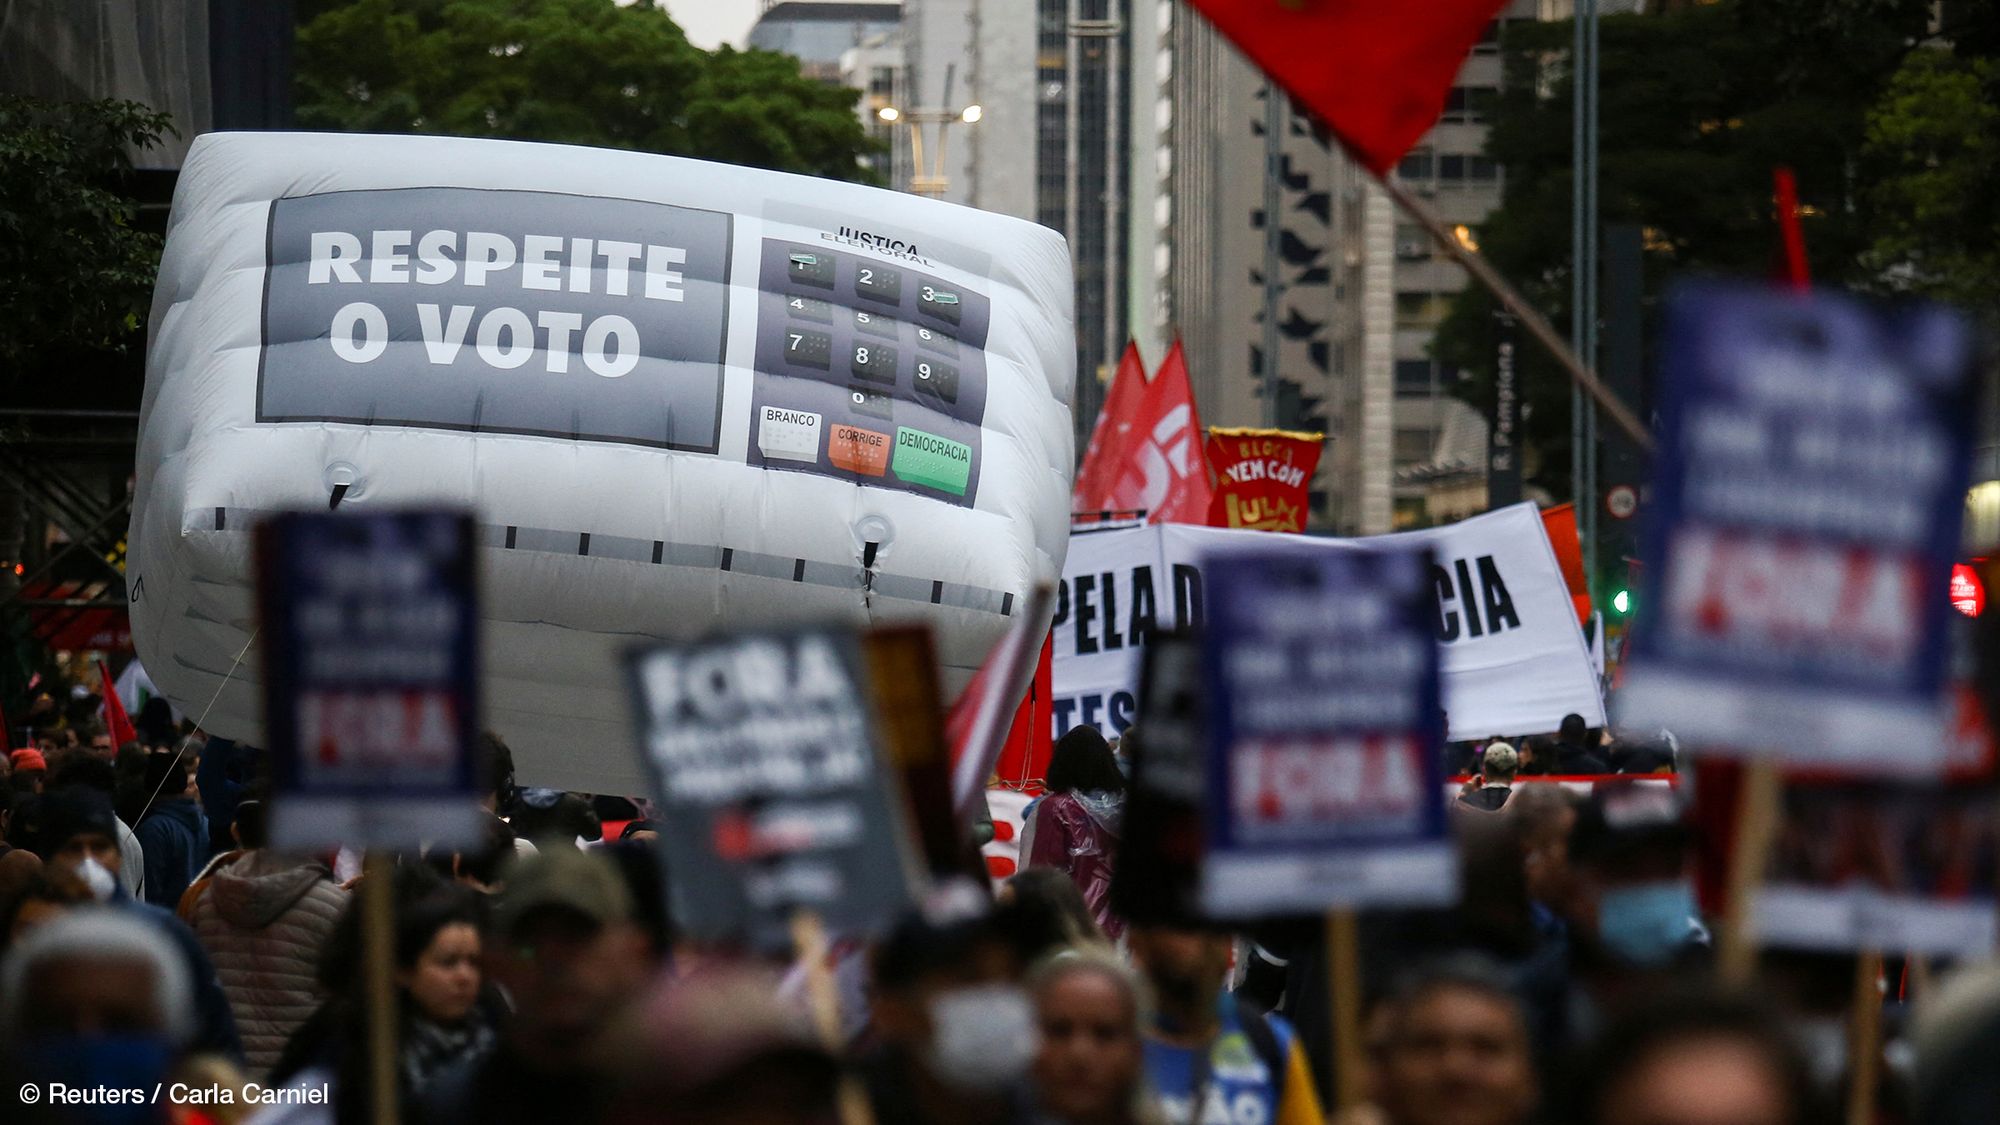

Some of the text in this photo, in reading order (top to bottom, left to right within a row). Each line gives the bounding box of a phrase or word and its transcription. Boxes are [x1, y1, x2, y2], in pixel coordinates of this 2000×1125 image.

[820, 232, 936, 269] ELEITORAL
[307, 229, 687, 302] RESPEITE
[859, 269, 873, 285] 2
[922, 286, 935, 302] 3
[790, 298, 804, 310] 4
[857, 312, 870, 324] 5
[330, 302, 641, 378] O VOTO
[789, 334, 803, 351] 7
[918, 328, 932, 341] 6
[855, 347, 869, 364] 8
[918, 363, 931, 380] 9
[852, 392, 865, 404] 0
[766, 410, 815, 427] BRANCO
[838, 428, 883, 447] CORRIGE
[899, 431, 969, 463] DEMOCRACIA
[1225, 458, 1306, 488] VEM COM
